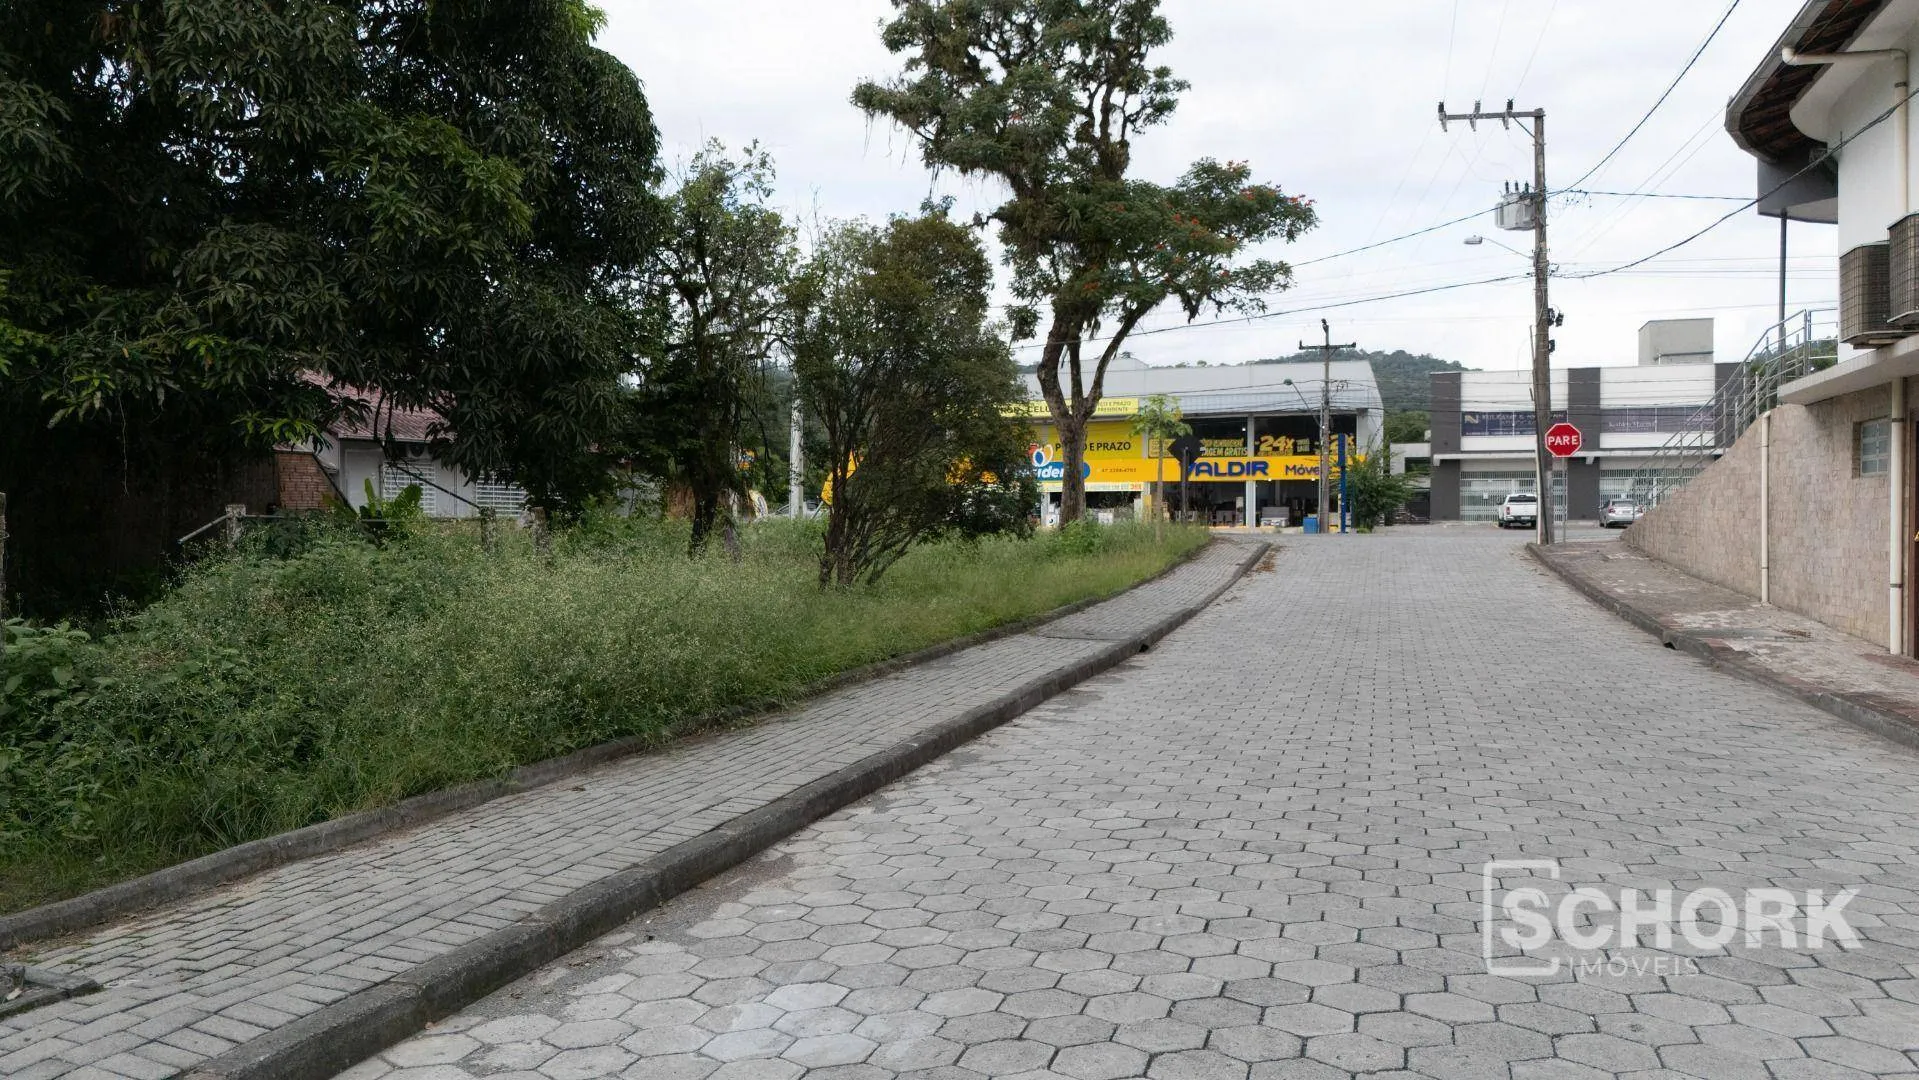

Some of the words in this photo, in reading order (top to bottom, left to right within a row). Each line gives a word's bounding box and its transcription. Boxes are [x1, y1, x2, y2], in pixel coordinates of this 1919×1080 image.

[1089, 442, 1095, 451] E
[1096, 441, 1131, 451] PRAZO
[1548, 435, 1580, 446] PARE
[1285, 463, 1320, 476] Móve
